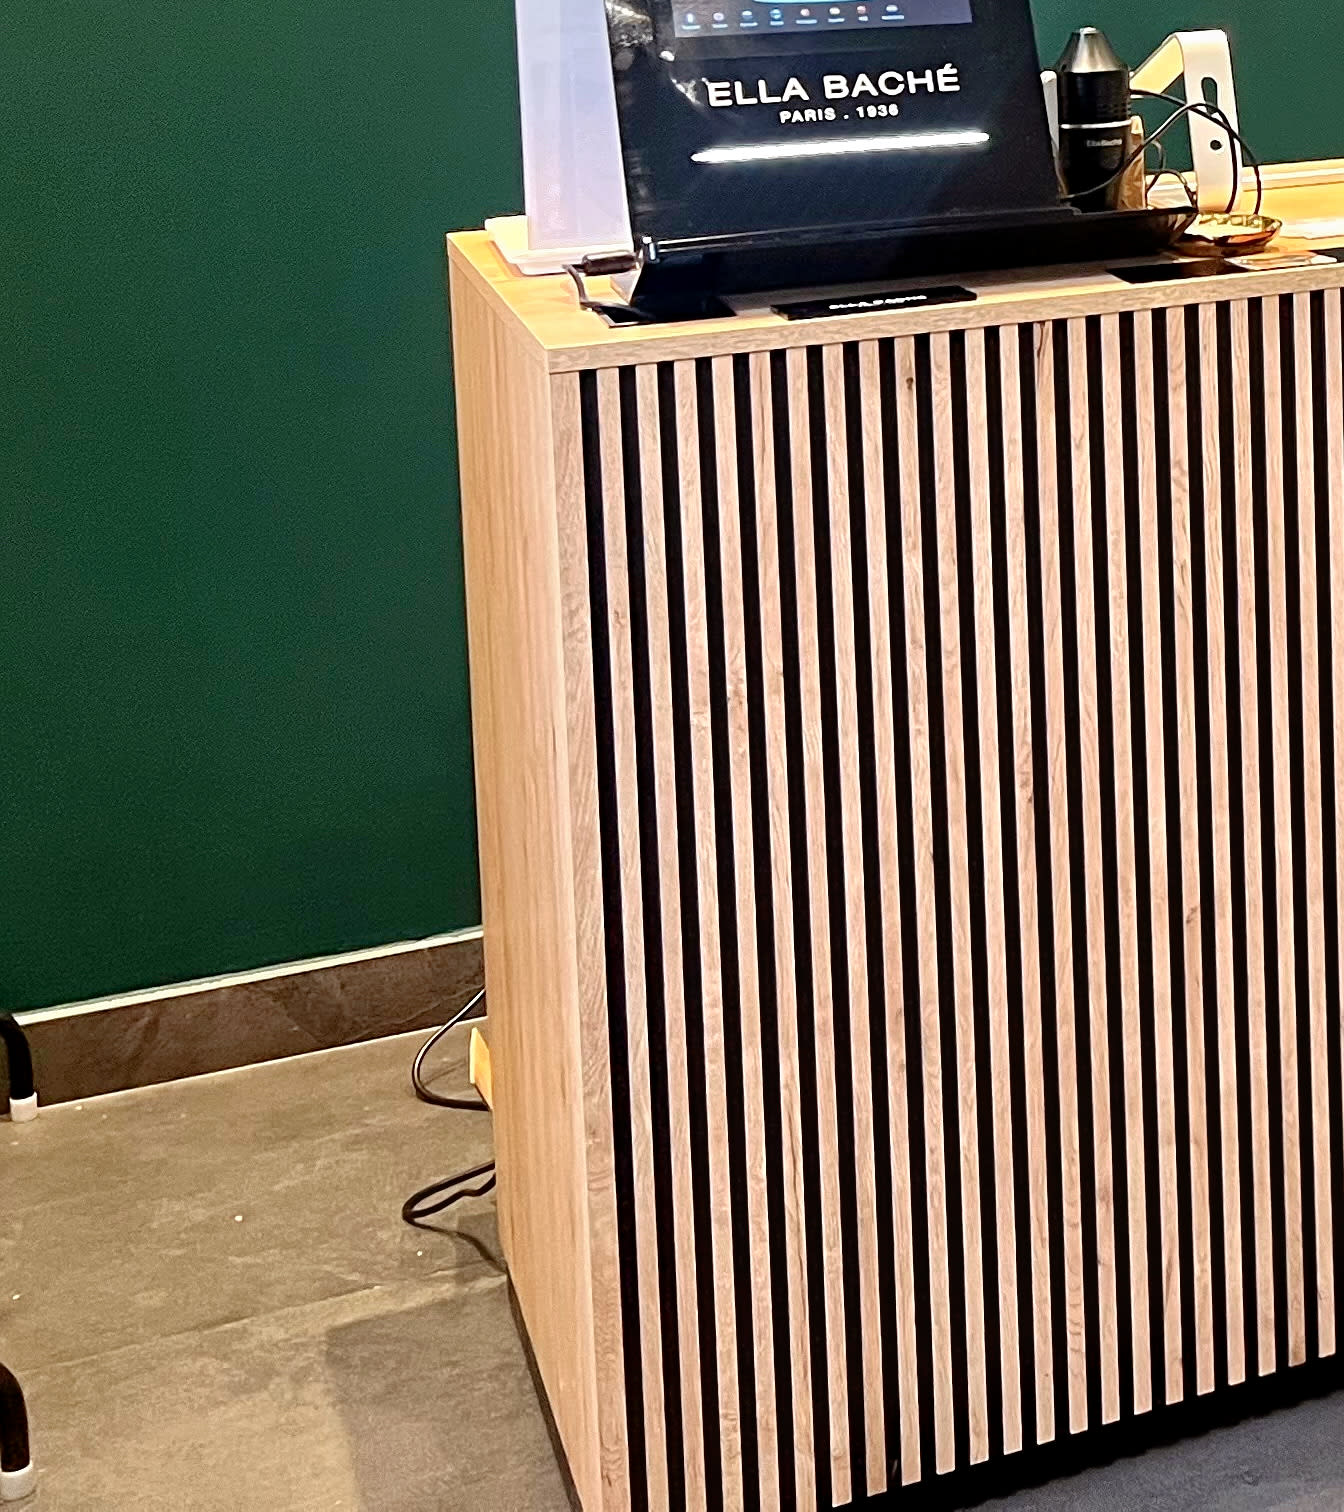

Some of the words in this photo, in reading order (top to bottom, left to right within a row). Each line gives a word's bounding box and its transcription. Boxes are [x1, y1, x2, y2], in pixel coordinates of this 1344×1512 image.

[708, 77, 810, 107] ELLA
[823, 63, 961, 99] BACHÉ
[779, 107, 836, 124] PARIS
